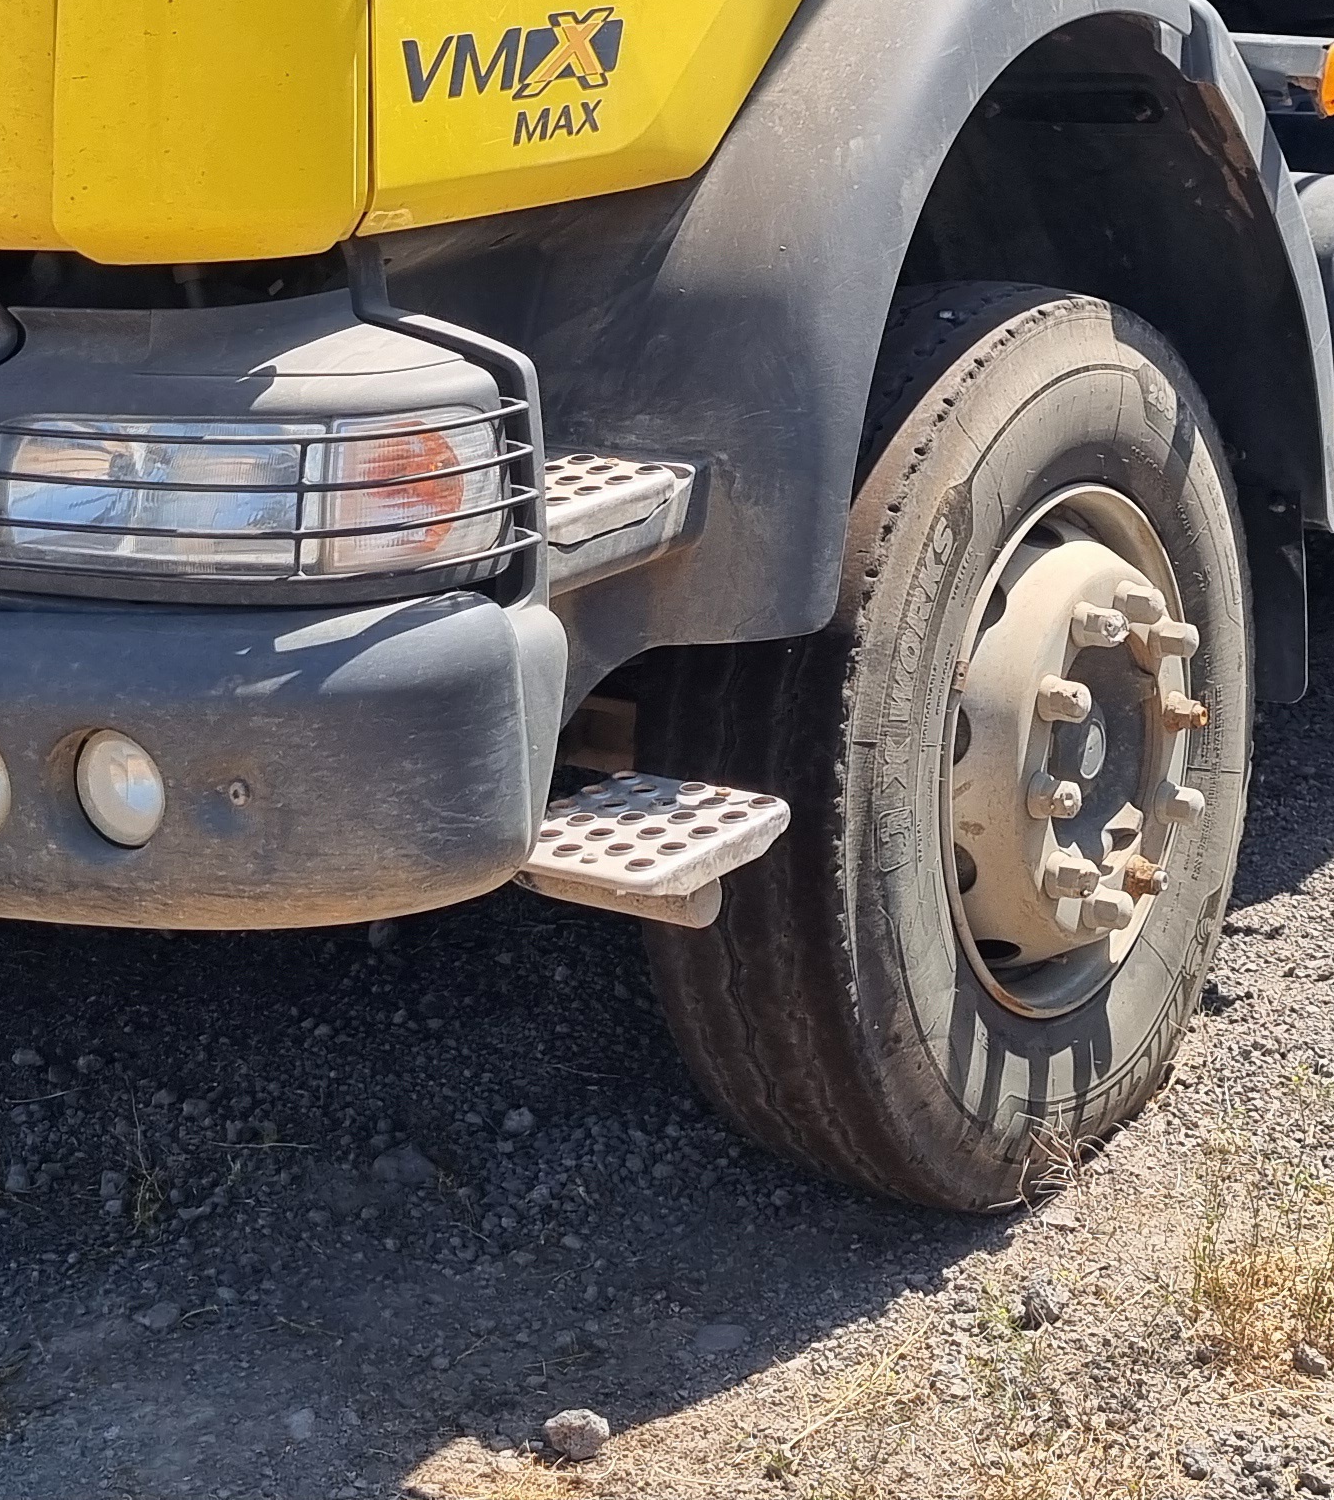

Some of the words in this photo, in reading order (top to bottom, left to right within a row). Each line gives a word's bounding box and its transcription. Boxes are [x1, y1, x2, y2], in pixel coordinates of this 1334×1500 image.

[402, 7, 624, 103] VMX
[513, 99, 602, 147] MAX
[889, 516, 954, 722] WORKS
